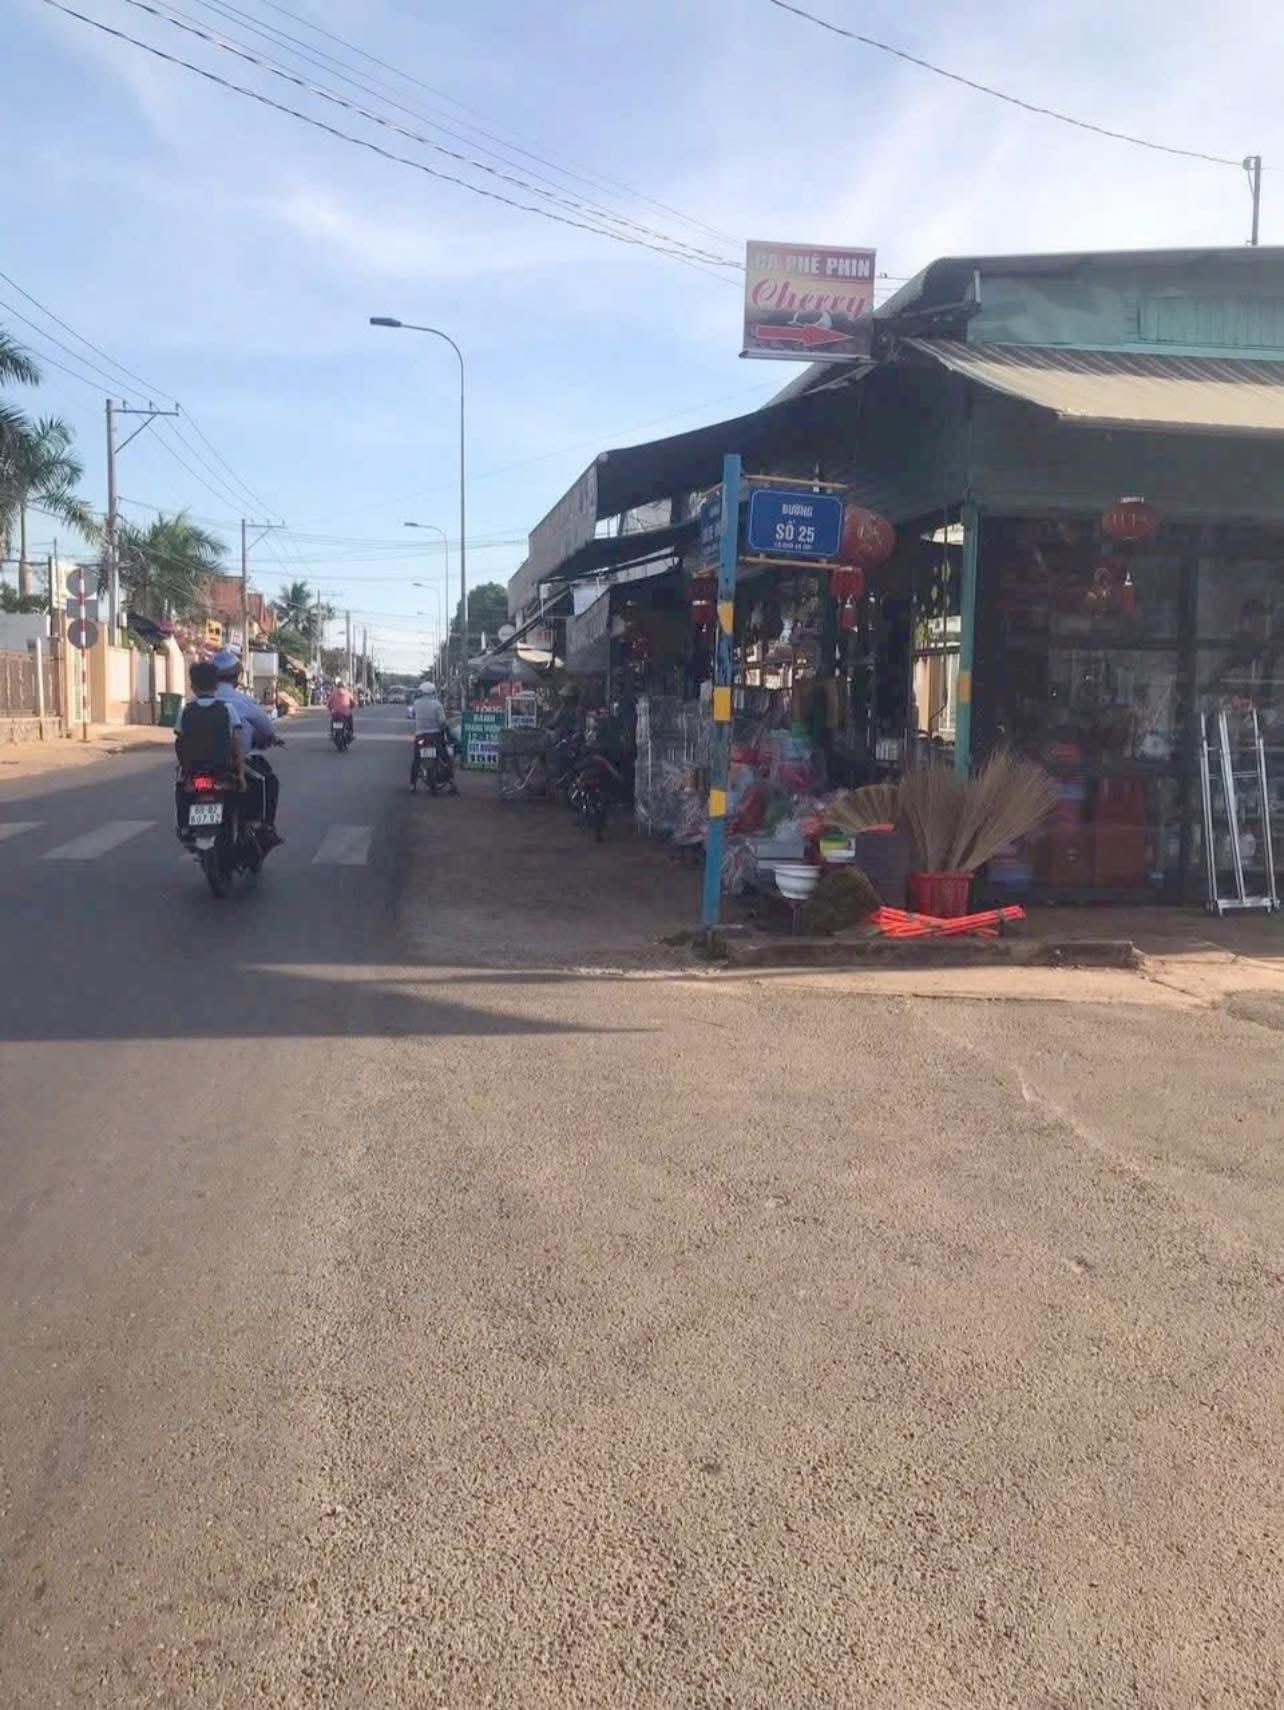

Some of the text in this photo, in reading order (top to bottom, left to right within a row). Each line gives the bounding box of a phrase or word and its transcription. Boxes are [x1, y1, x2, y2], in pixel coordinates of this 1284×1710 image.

[825, 256, 870, 278] PHIN
[751, 278, 867, 320] Cherry
[775, 519, 816, 543] SỐ 25
